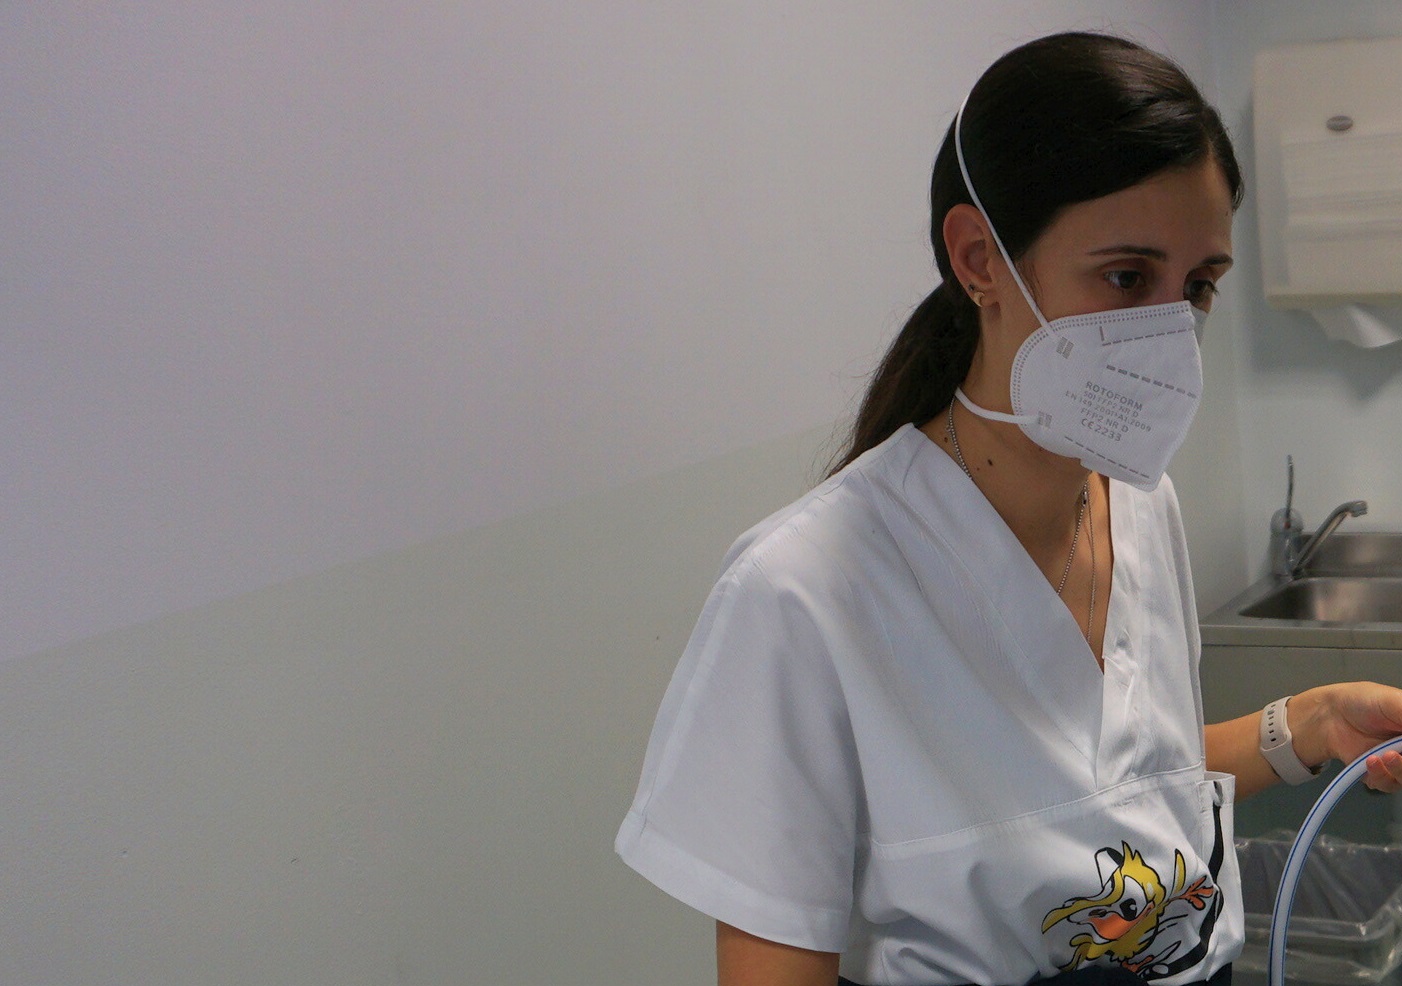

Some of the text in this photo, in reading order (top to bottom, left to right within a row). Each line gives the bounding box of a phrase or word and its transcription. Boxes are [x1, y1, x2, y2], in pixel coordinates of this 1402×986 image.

[1086, 381, 1142, 412] ROTOFORM
[1080, 407, 1130, 433] FFP2 NR D
